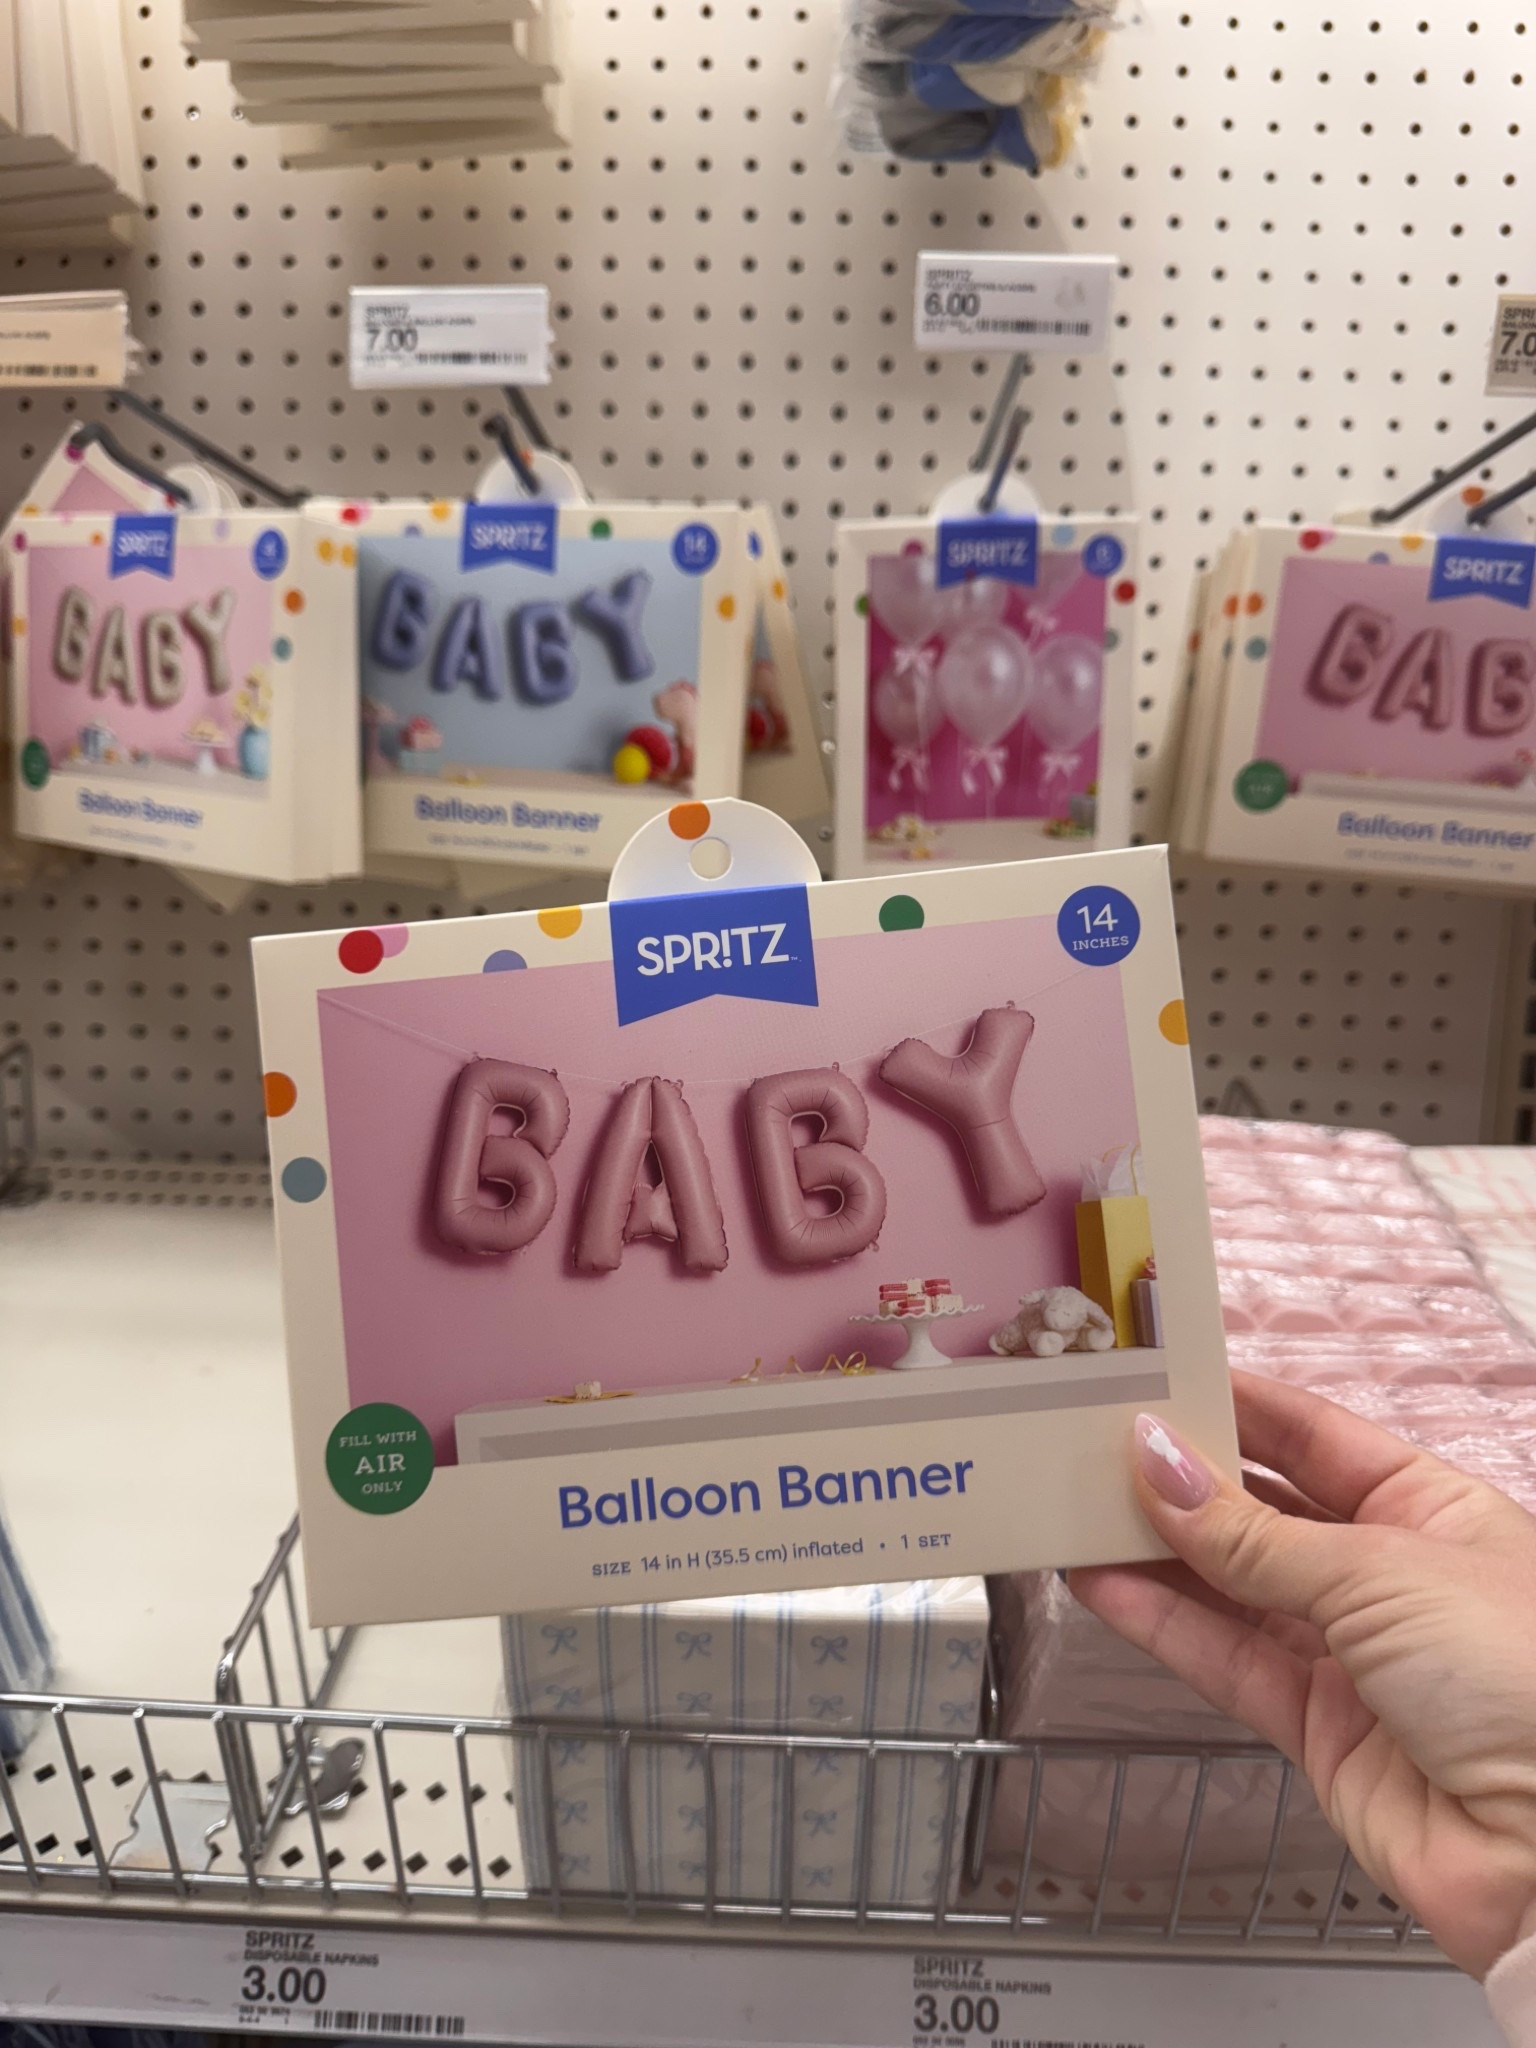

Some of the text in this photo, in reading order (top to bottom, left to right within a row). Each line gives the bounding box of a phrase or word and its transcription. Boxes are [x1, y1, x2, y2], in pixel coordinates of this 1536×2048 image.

[925, 292, 980, 317] 6.00
[366, 328, 418, 352] 7.00
[53, 586, 236, 709] BABY
[373, 568, 654, 707] BABY
[415, 794, 603, 833] Balloon Banner
[1337, 811, 1535, 850] Balloon Banner
[1077, 903, 1118, 934] 14
[1072, 936, 1129, 951] INCHES
[433, 1000, 1047, 1273] BABY
[340, 1430, 417, 1448] FILL WITH
[355, 1453, 406, 1475] AIR
[362, 1480, 403, 1494] ONLY
[558, 1460, 974, 1528] Balloon Banner
[592, 1533, 952, 1576] SIZE 14 in H (35.5 cm) inflated 1 SET
[245, 1930, 315, 1949] SPRITZ
[244, 1950, 379, 1967] DISPOSABLE NAPKINS
[914, 1956, 984, 1977] SPRITZ
[242, 1965, 326, 2004] 3.00
[914, 1978, 1052, 1996] DISPOSABLE NAPKINS
[914, 1993, 999, 2034] 3.00
